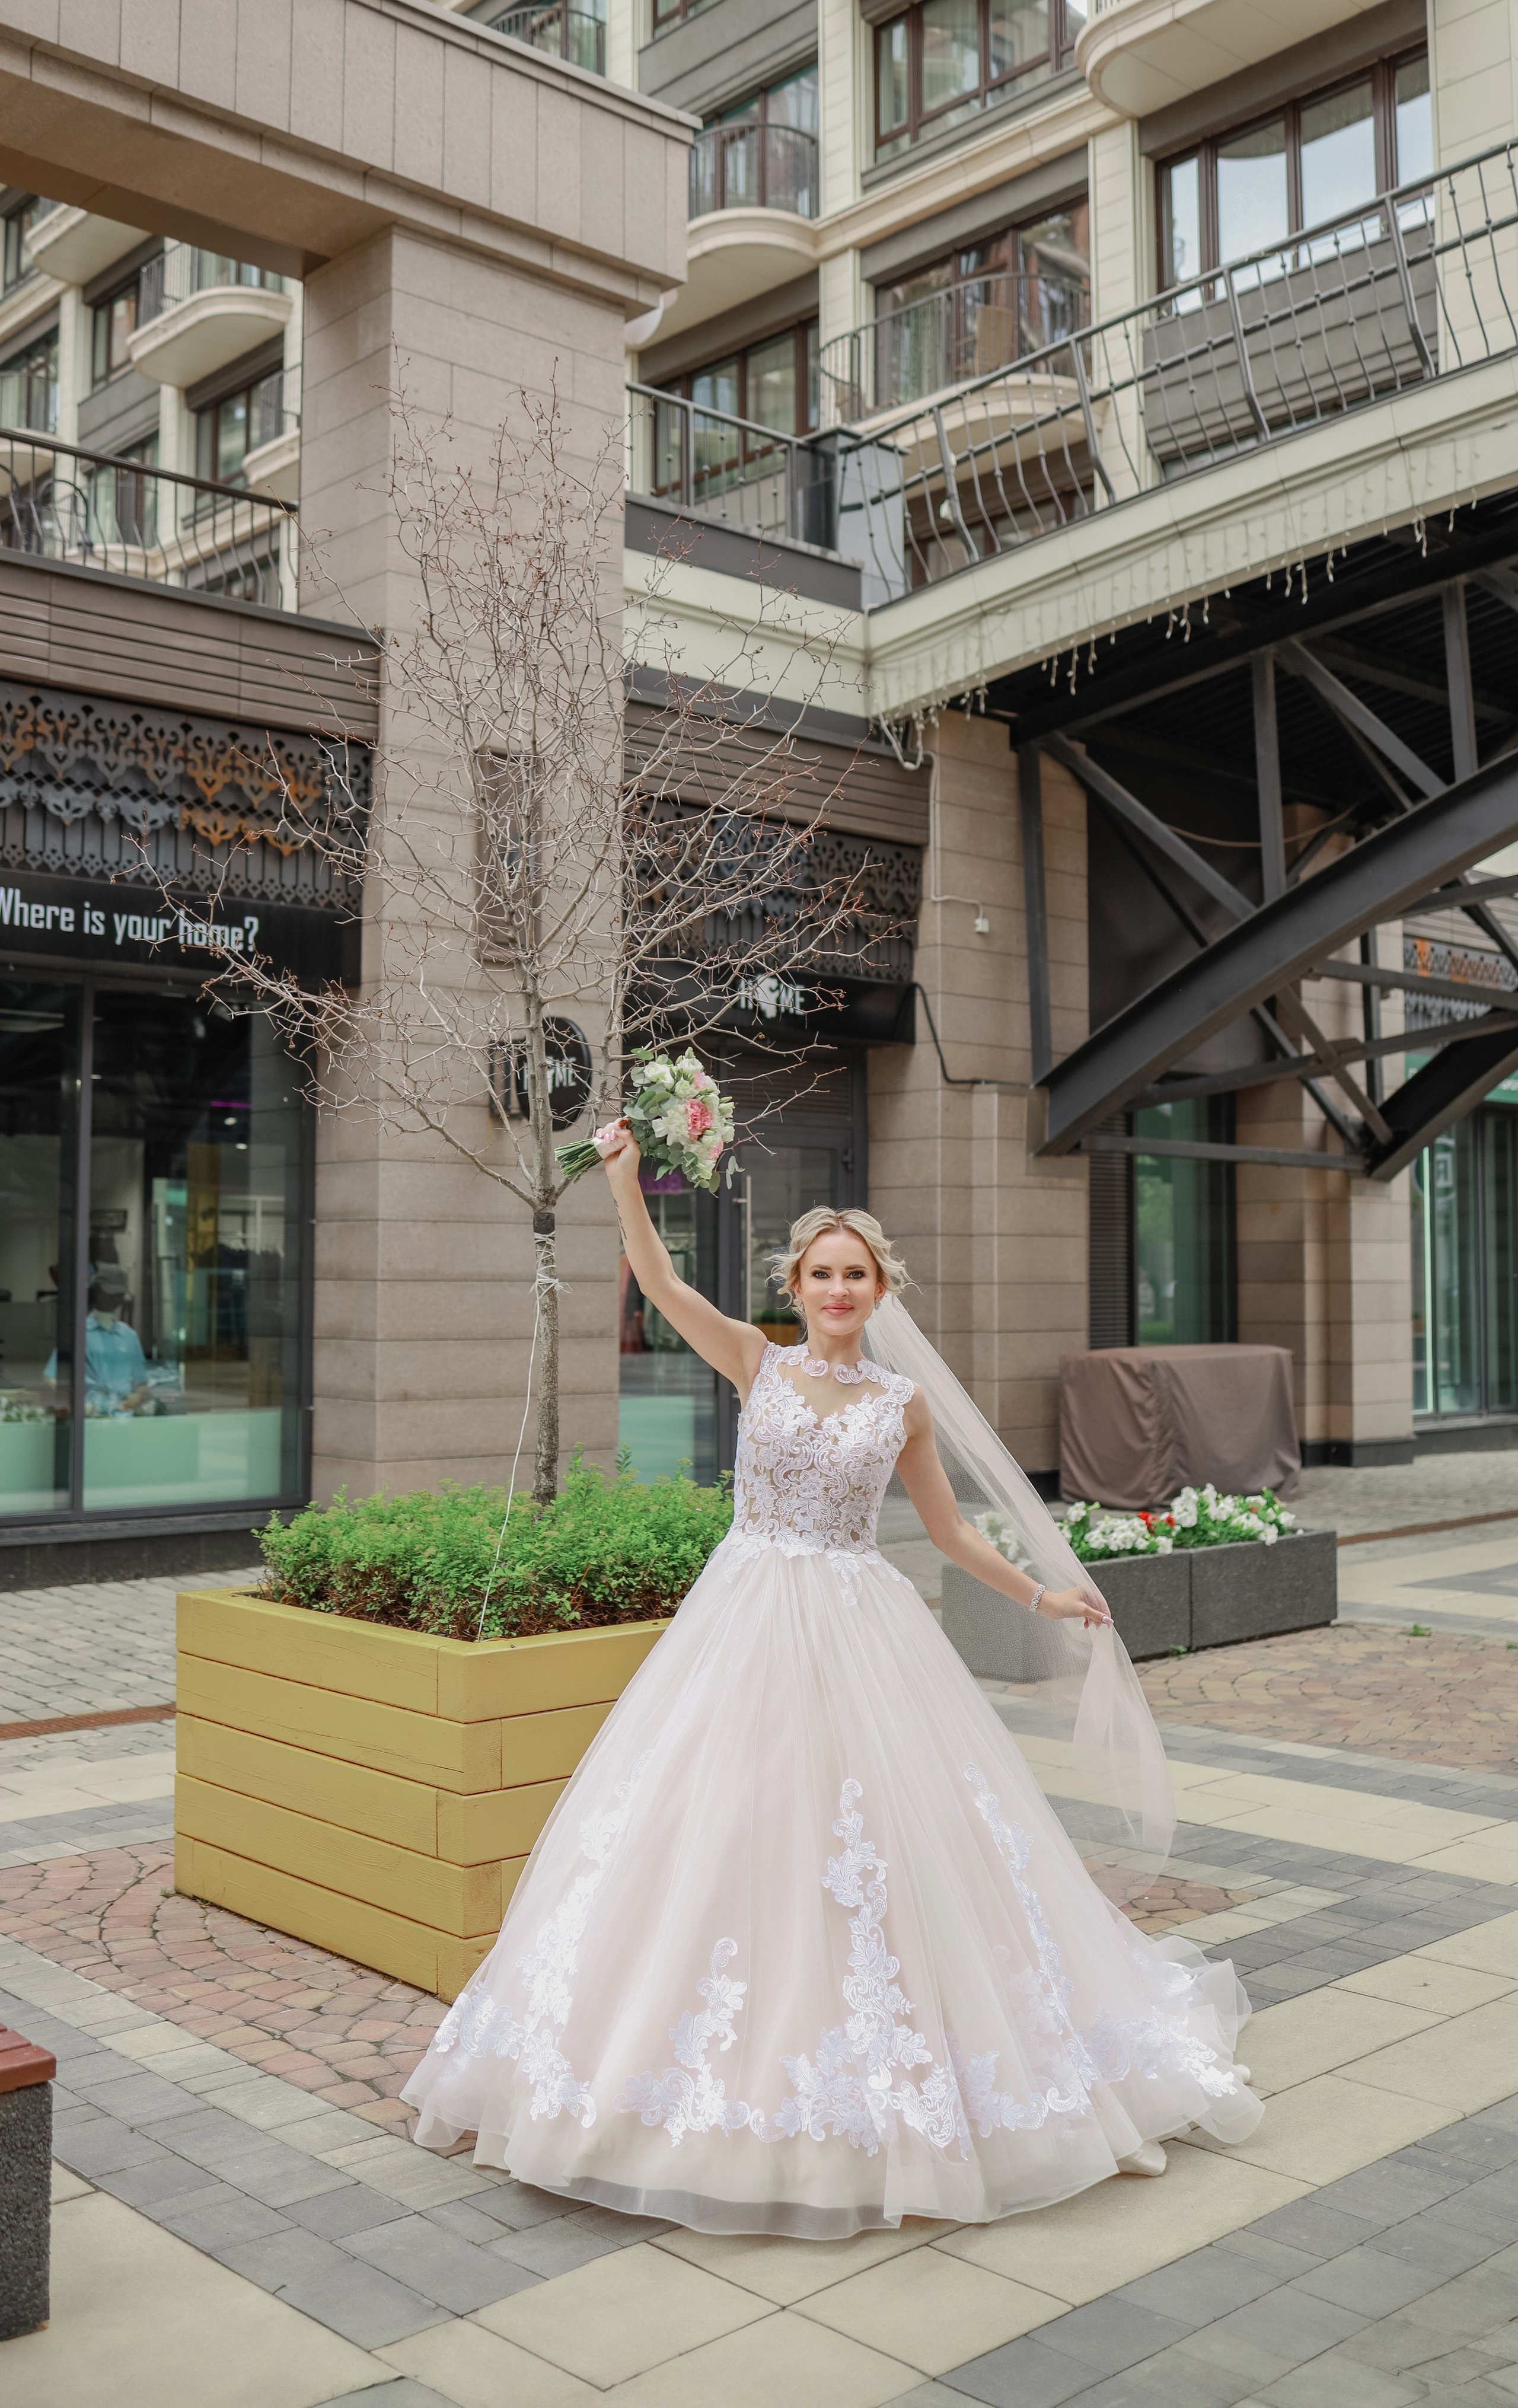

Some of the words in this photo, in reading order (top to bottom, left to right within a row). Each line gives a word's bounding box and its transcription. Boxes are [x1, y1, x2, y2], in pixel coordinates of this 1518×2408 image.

[0, 886, 75, 932] Where
[84, 901, 106, 936] is
[113, 912, 171, 946] your
[178, 908, 259, 952] home?
